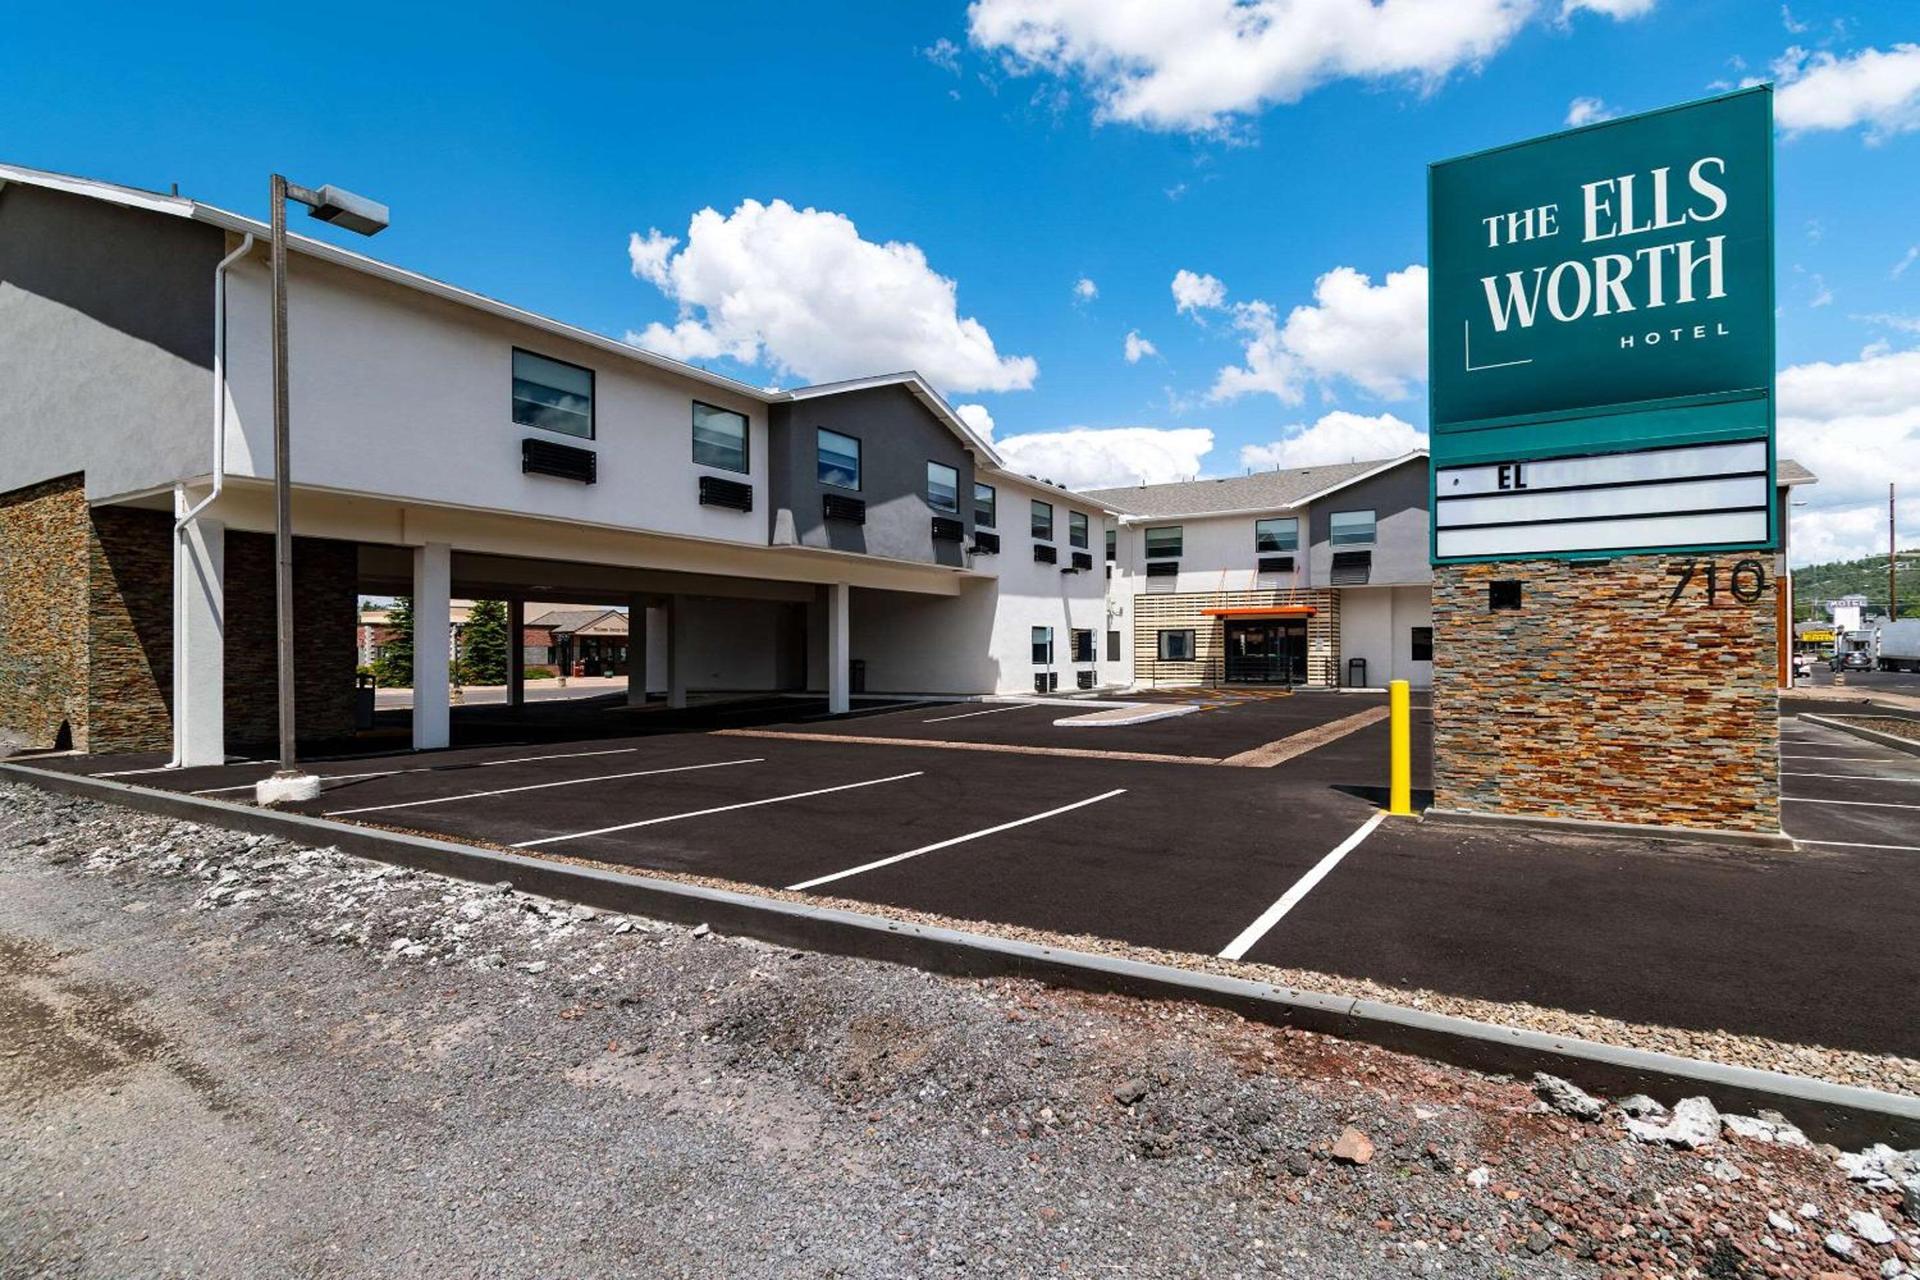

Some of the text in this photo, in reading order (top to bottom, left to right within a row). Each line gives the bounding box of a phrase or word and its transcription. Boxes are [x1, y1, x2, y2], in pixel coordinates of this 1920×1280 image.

[1483, 156, 1728, 248] THE ELLS
[1480, 235, 1727, 333] WORTH
[1620, 322, 1730, 349] HOTEL
[1498, 464, 1528, 489] EL
[1665, 558, 1765, 609] 710
